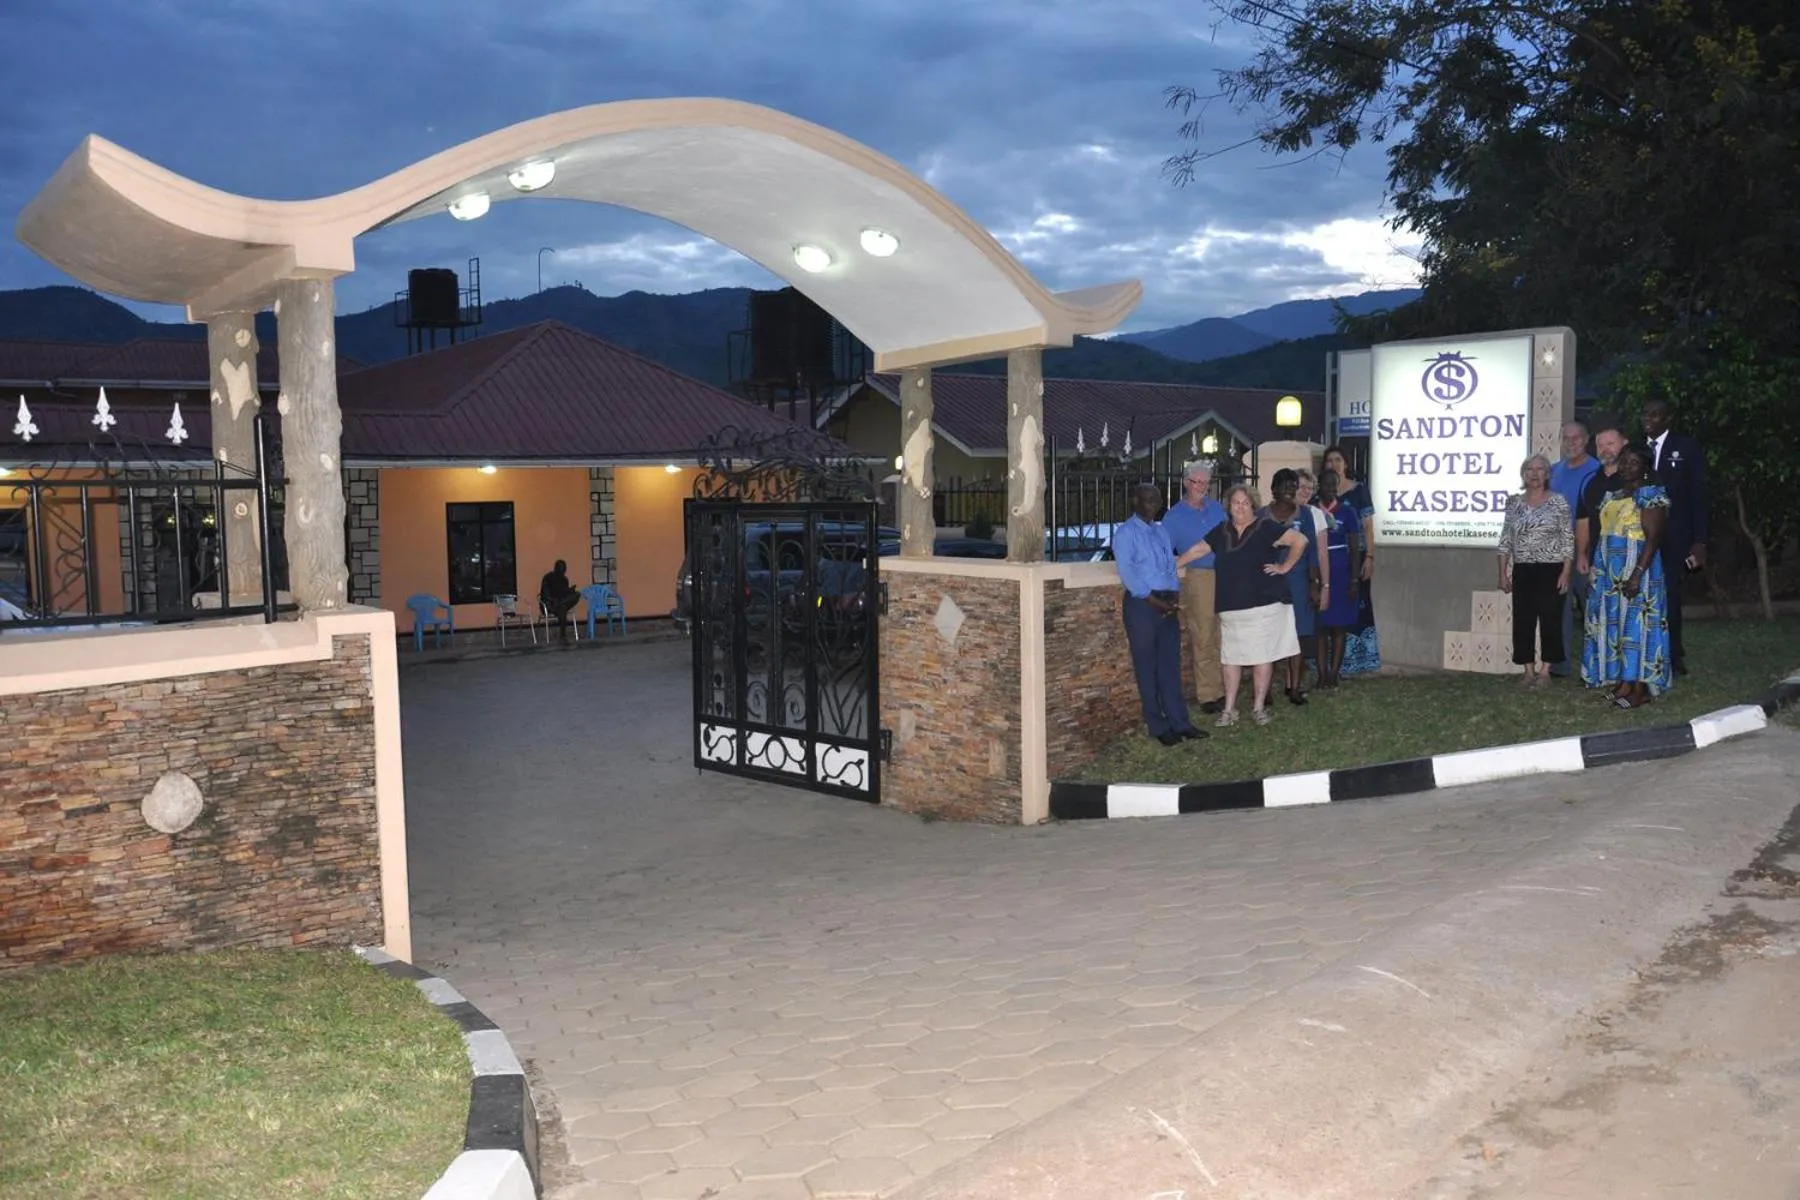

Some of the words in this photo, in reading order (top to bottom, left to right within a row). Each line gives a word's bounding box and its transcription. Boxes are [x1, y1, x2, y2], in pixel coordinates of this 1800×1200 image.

[1377, 414, 1525, 440] SANDTON
[1396, 452, 1502, 475] HOTEL
[1388, 490, 1510, 512] KASESE
